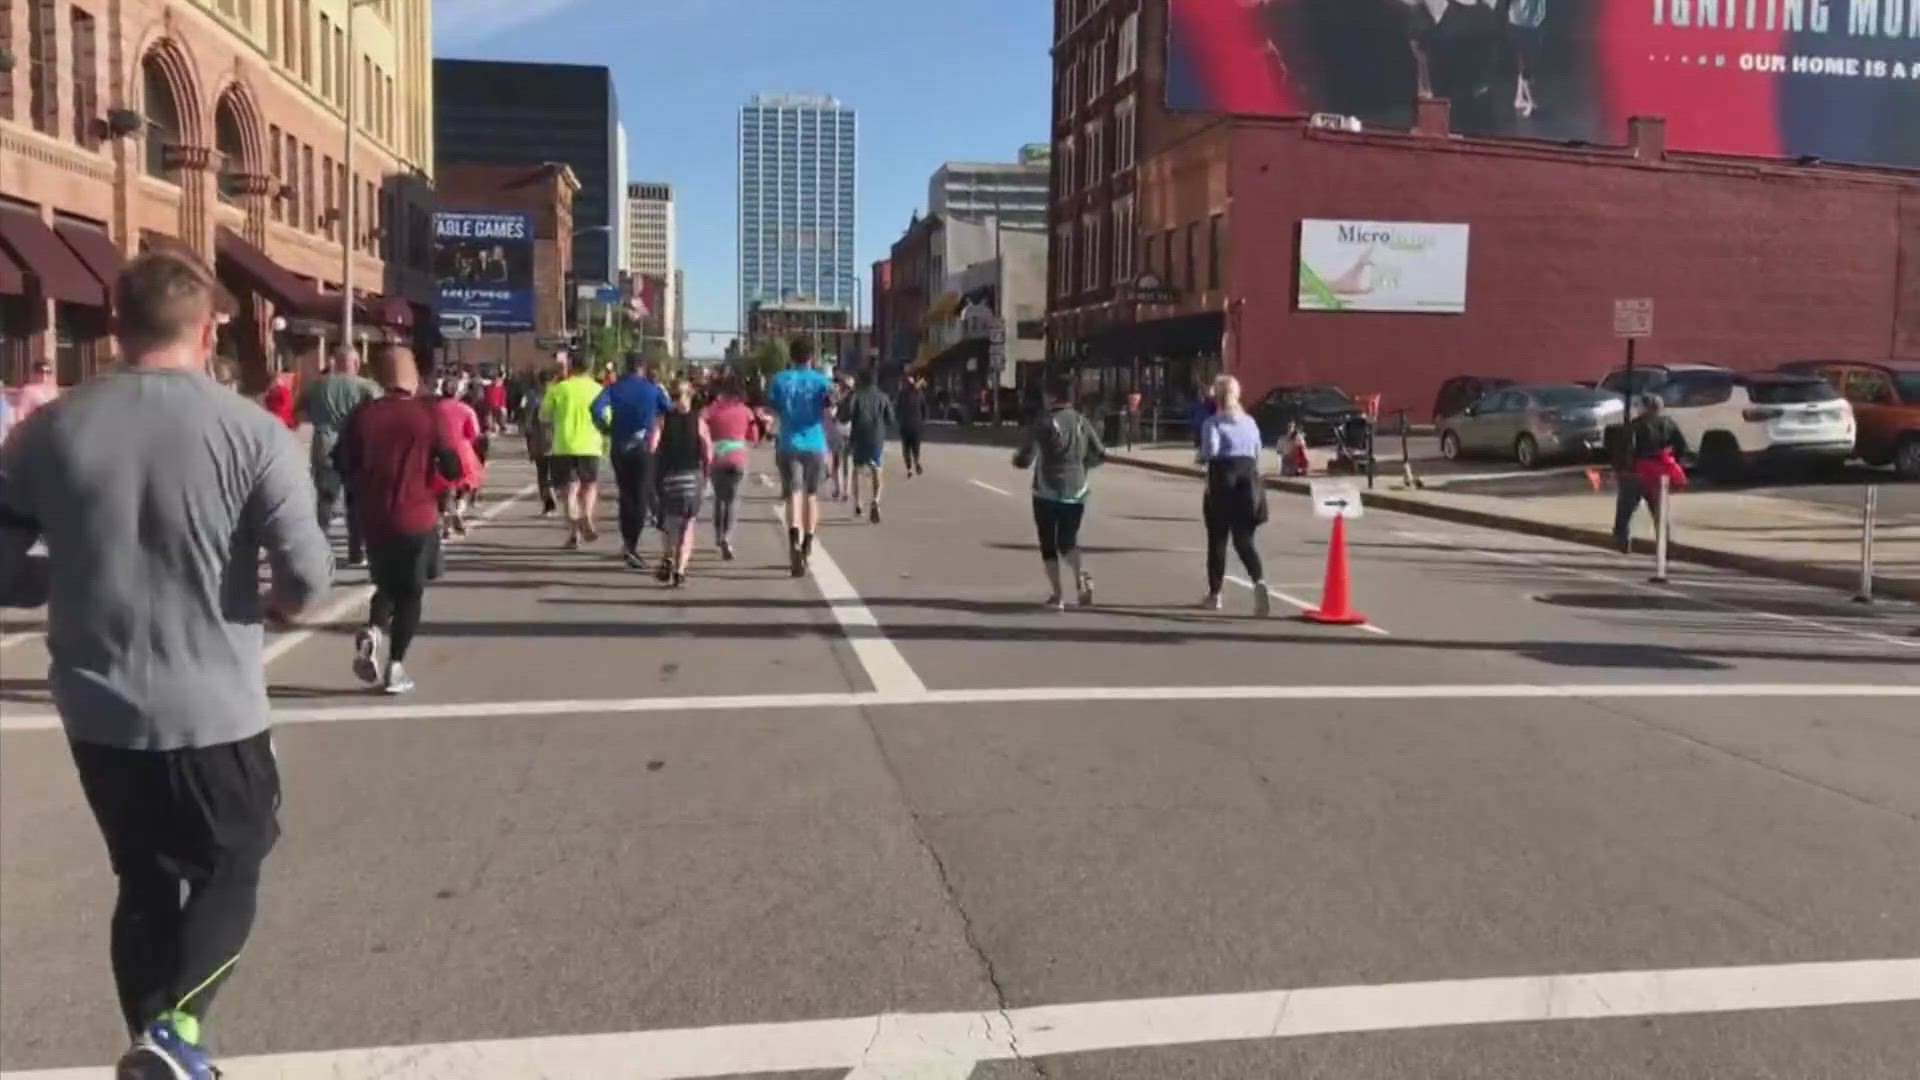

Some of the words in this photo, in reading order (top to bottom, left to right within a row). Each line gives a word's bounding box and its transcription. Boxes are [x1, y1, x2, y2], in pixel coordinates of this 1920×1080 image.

[1739, 52, 1787, 73] OUR
[1792, 54, 1859, 77] HOME
[1864, 59, 1888, 79] IS
[1891, 61, 1908, 80] A
[474, 221, 524, 239] GAMES
